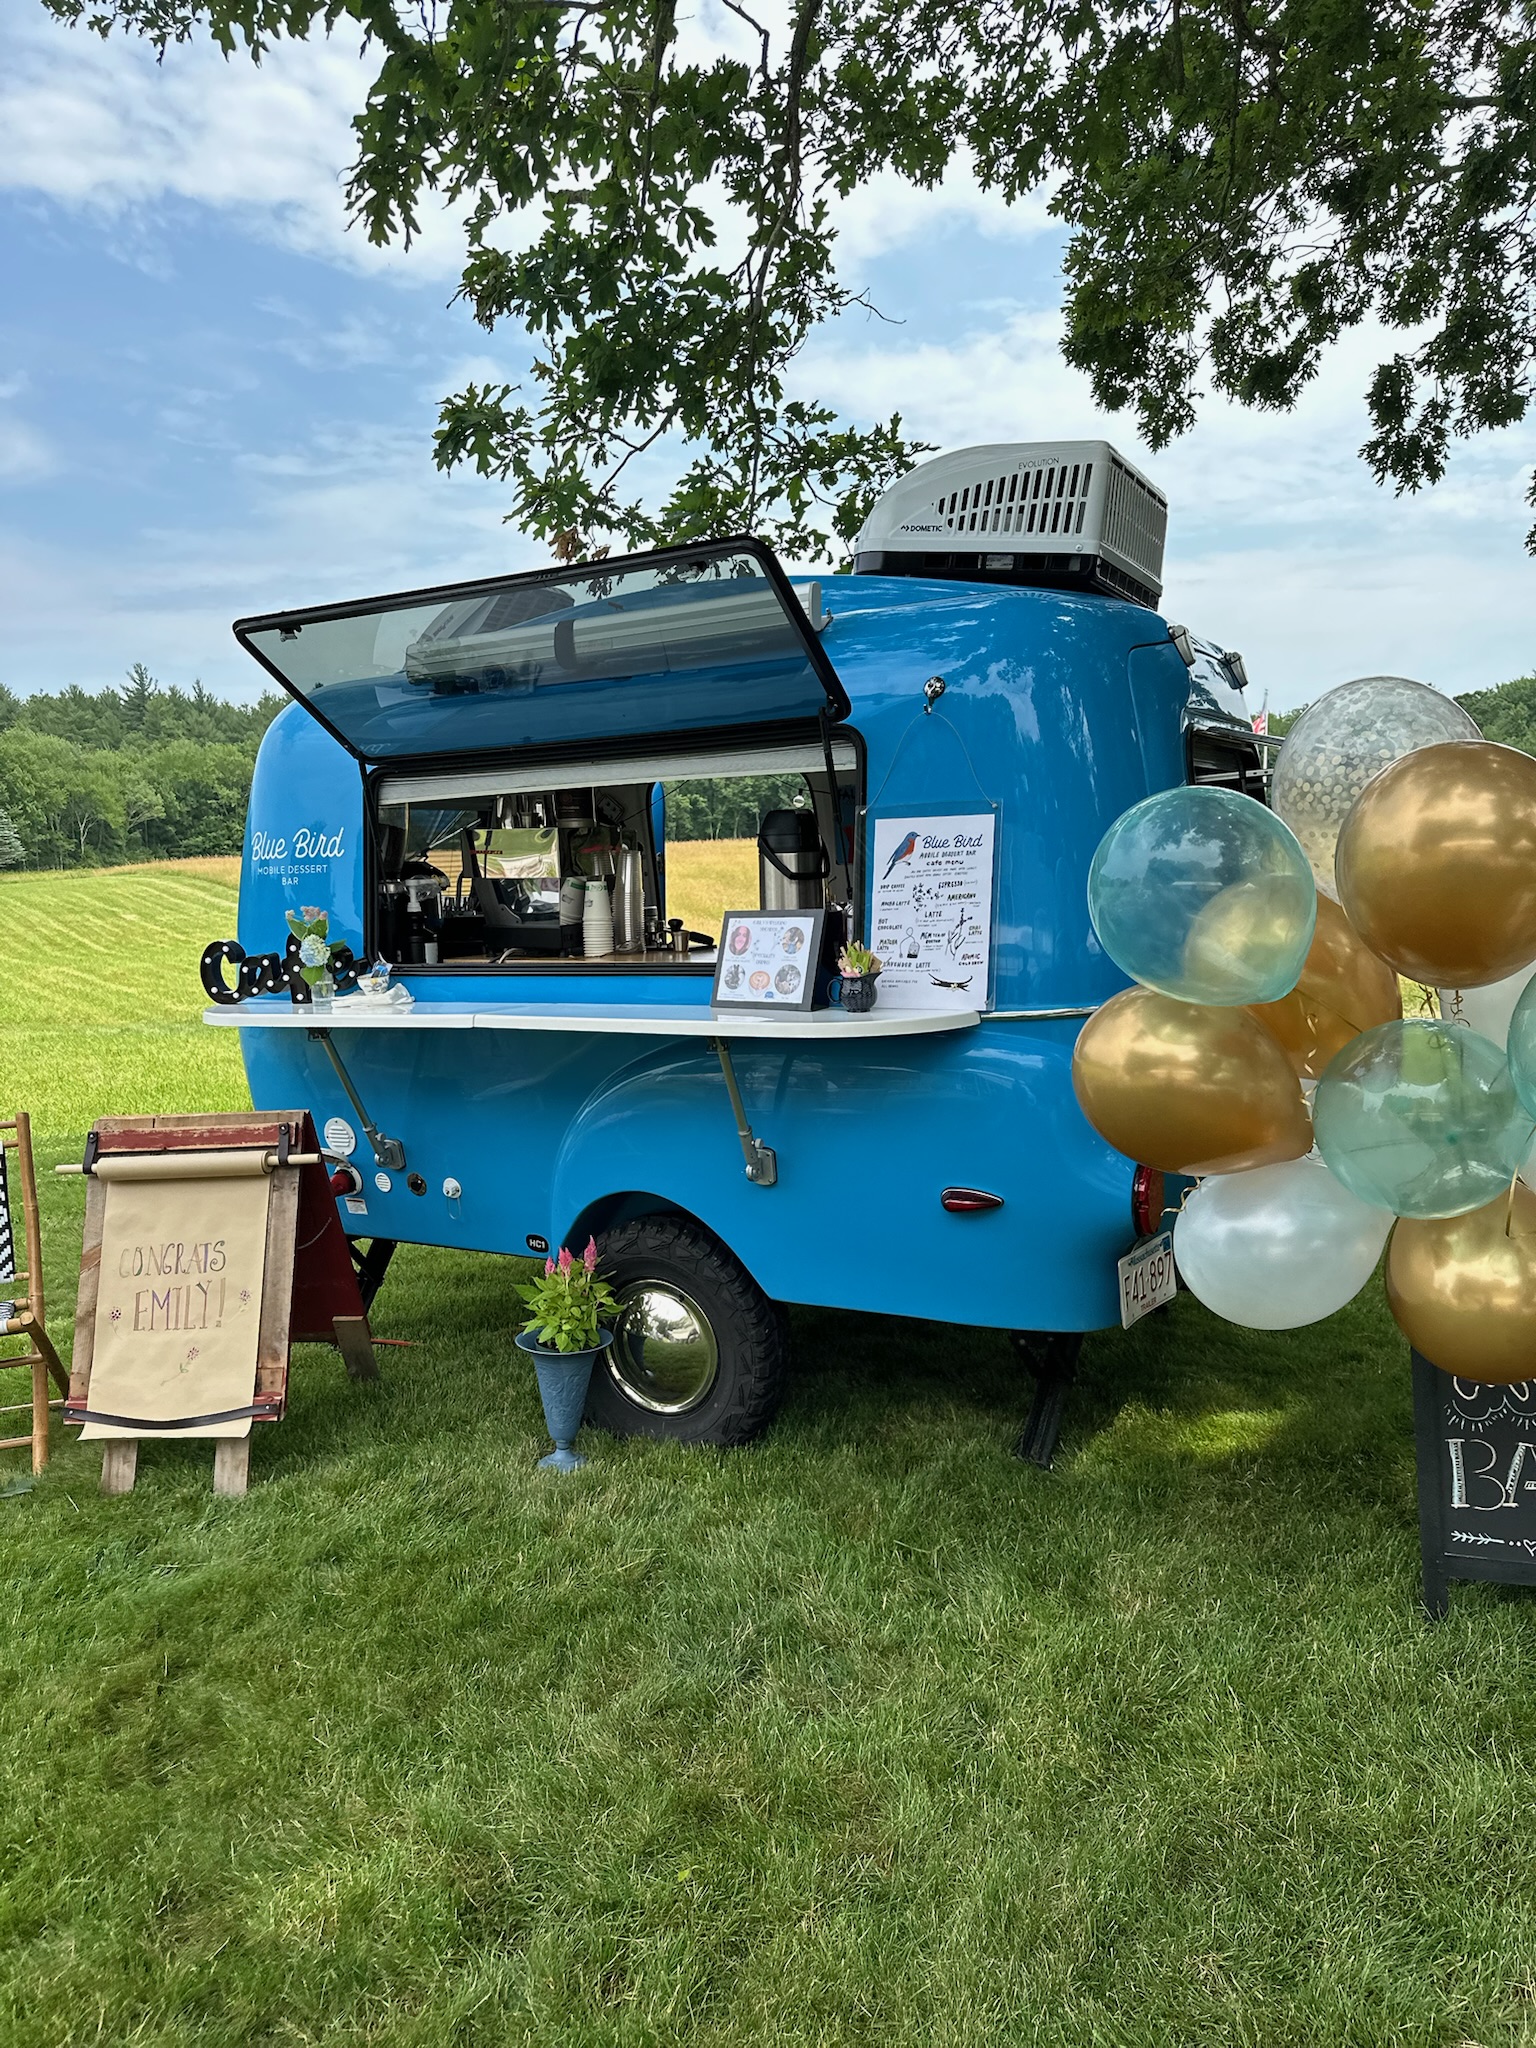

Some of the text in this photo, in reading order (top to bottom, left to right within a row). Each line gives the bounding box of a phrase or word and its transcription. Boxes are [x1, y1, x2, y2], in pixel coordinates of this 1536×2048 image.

[1018, 457, 1060, 470] EVOLUTION
[910, 525, 943, 533] DOMETIC
[251, 827, 345, 861] Blue Bird
[922, 833, 983, 849] Blue Bird
[257, 864, 328, 875] MOBILE DESSERT
[281, 876, 299, 886] BAR
[938, 880, 963, 889] ESPRESSO
[529, 1239, 546, 1249] HC1
[118, 1240, 227, 1279] CONGRATS
[133, 1278, 227, 1333] EMILY!
[1141, 1296, 1157, 1311] TRAILER
